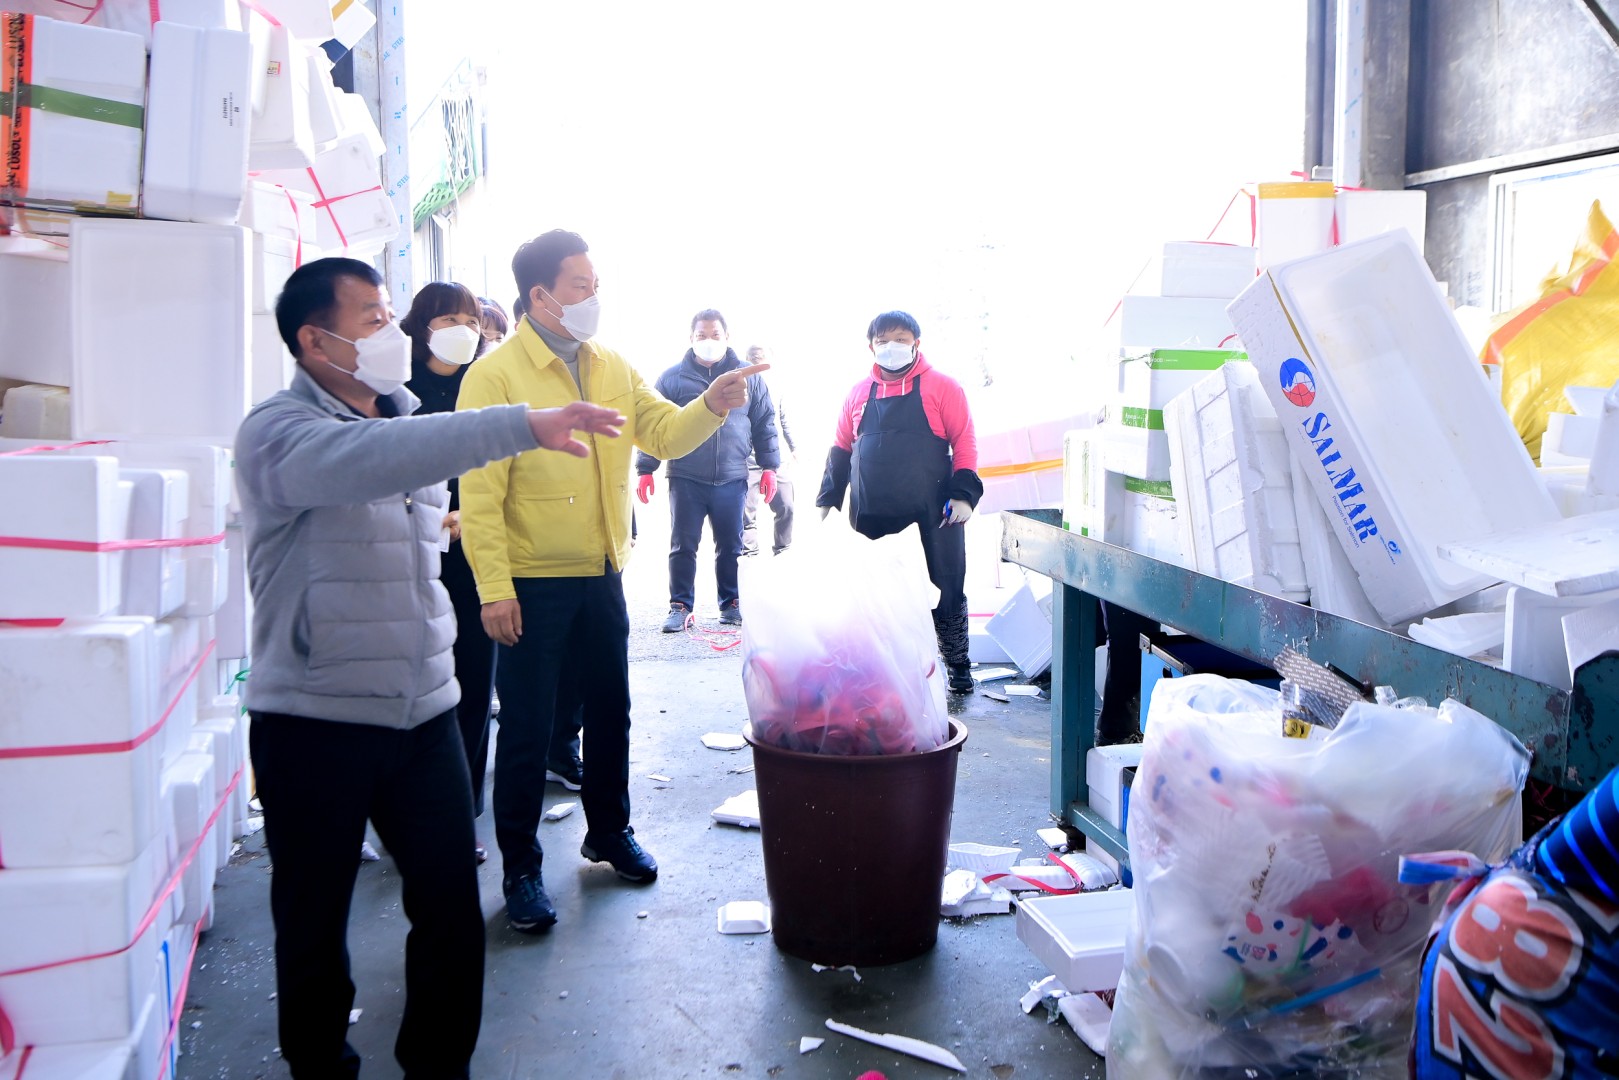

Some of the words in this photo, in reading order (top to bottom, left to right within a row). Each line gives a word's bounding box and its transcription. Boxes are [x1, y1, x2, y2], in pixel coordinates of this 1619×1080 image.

[1332, 495, 1344, 518] Passion
[1342, 517, 1350, 526] for
[1346, 525, 1360, 549] Salmon
[1432, 874, 1619, 1080] 82
